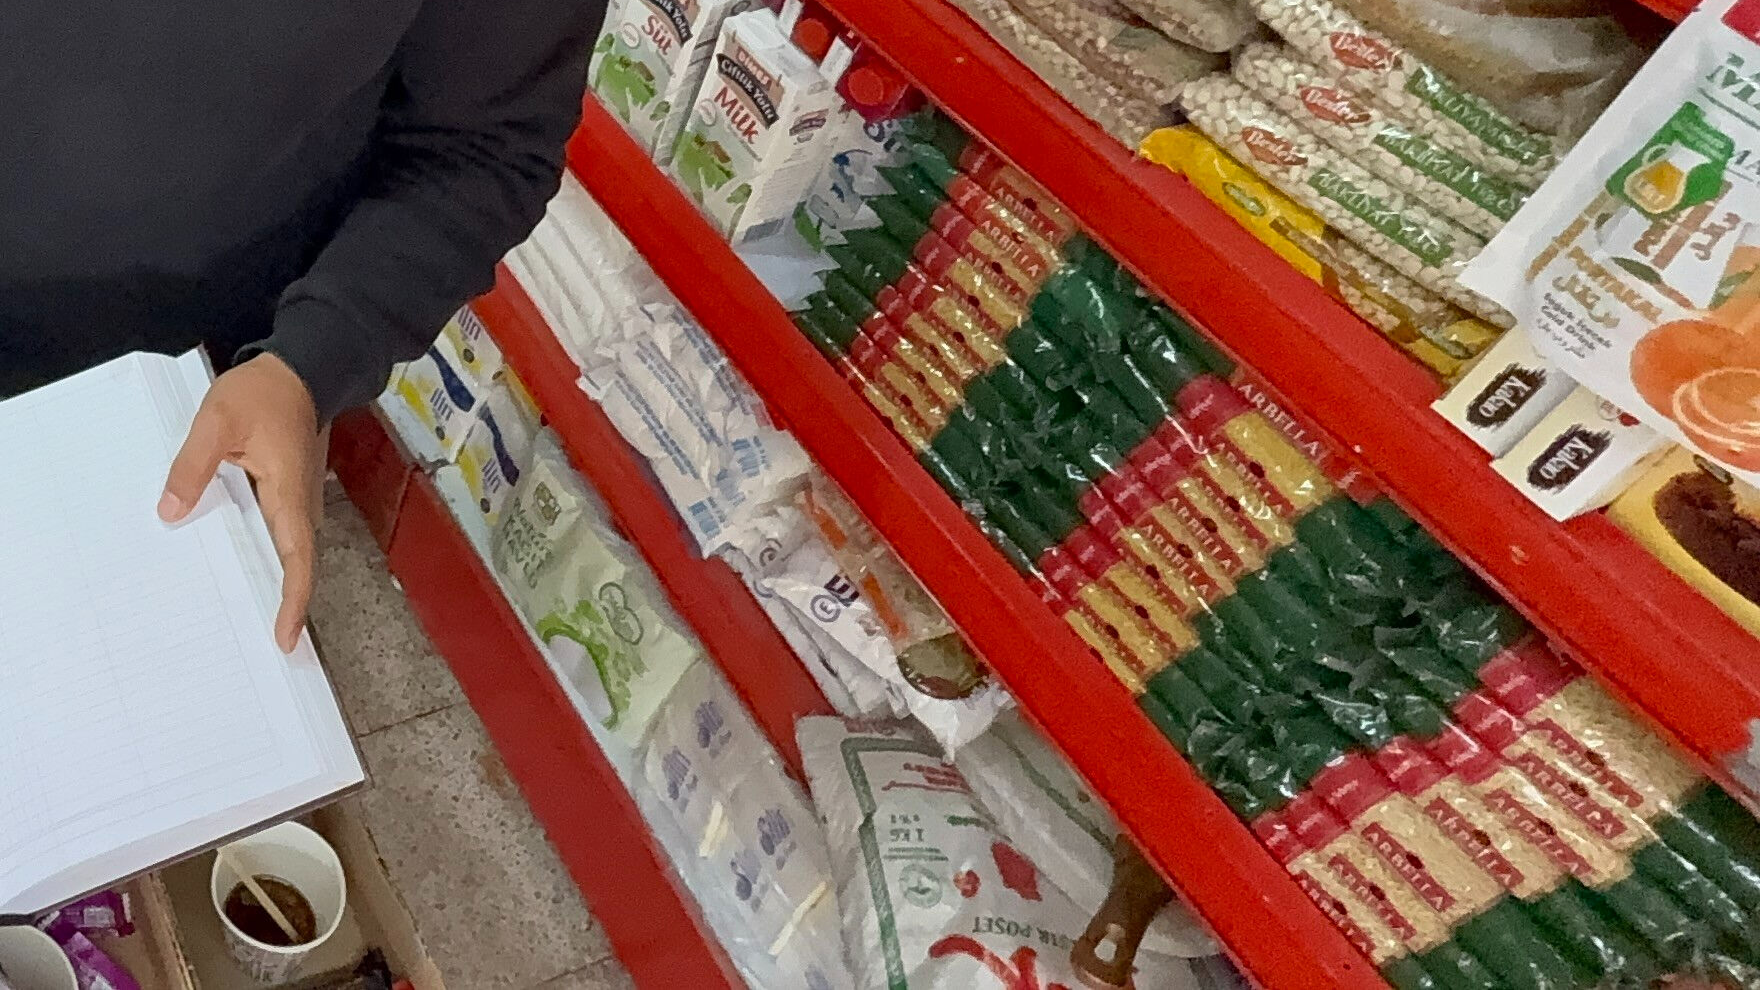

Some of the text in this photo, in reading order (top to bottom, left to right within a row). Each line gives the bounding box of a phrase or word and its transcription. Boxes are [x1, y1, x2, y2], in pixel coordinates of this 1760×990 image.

[713, 86, 760, 146] Milk
[1239, 383, 1322, 457] ARBELLA
[1479, 375, 1532, 418] Kakao
[1539, 436, 1596, 480] Kakao
[1366, 828, 1453, 910] ARBELLA
